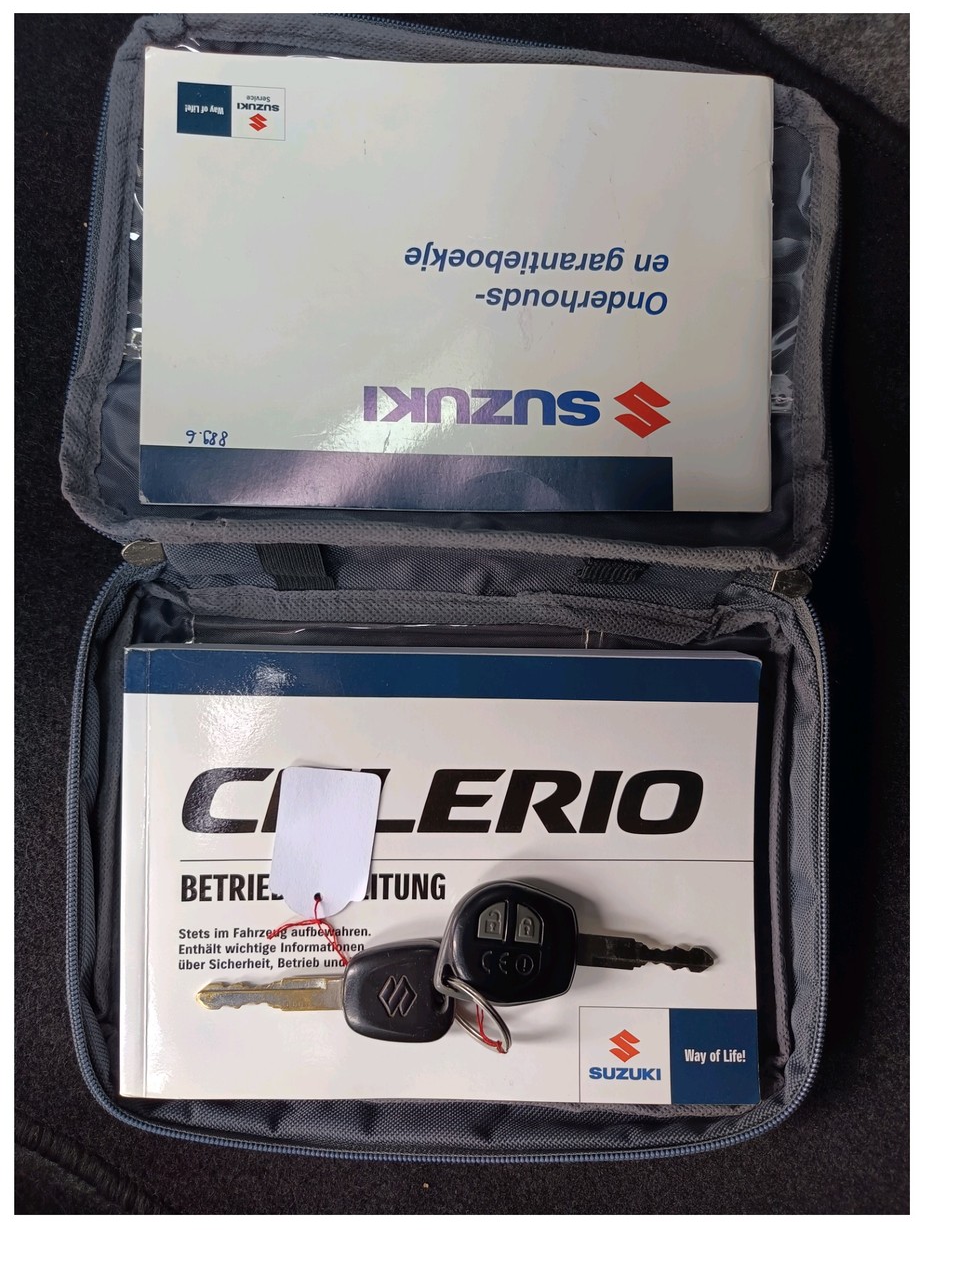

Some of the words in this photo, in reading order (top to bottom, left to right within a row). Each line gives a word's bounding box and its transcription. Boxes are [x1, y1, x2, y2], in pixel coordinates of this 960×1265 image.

[246, 95, 271, 103] Service
[184, 104, 200, 114] Life!
[200, 105, 209, 114] of
[209, 105, 225, 115] Way
[236, 102, 280, 112] SUZUKI
[404, 241, 625, 275] garantieboekje
[633, 253, 669, 273] en
[475, 287, 668, 315] Onderhouds-
[363, 385, 601, 426] SUZUKI
[181, 767, 704, 835] CERIO
[181, 872, 446, 902] BETRIEITUNG
[178, 928, 210, 939] Stets
[214, 928, 229, 938] im
[178, 943, 222, 955] Enthält
[225, 942, 277, 955] wichtige
[178, 958, 206, 970] über
[208, 957, 274, 971] Sicherheit,
[277, 956, 320, 968] Betrieb
[684, 1048, 706, 1065] Way
[709, 1048, 721, 1063] of
[723, 1049, 747, 1063] Life!
[588, 1066, 662, 1081] SUZUKI
